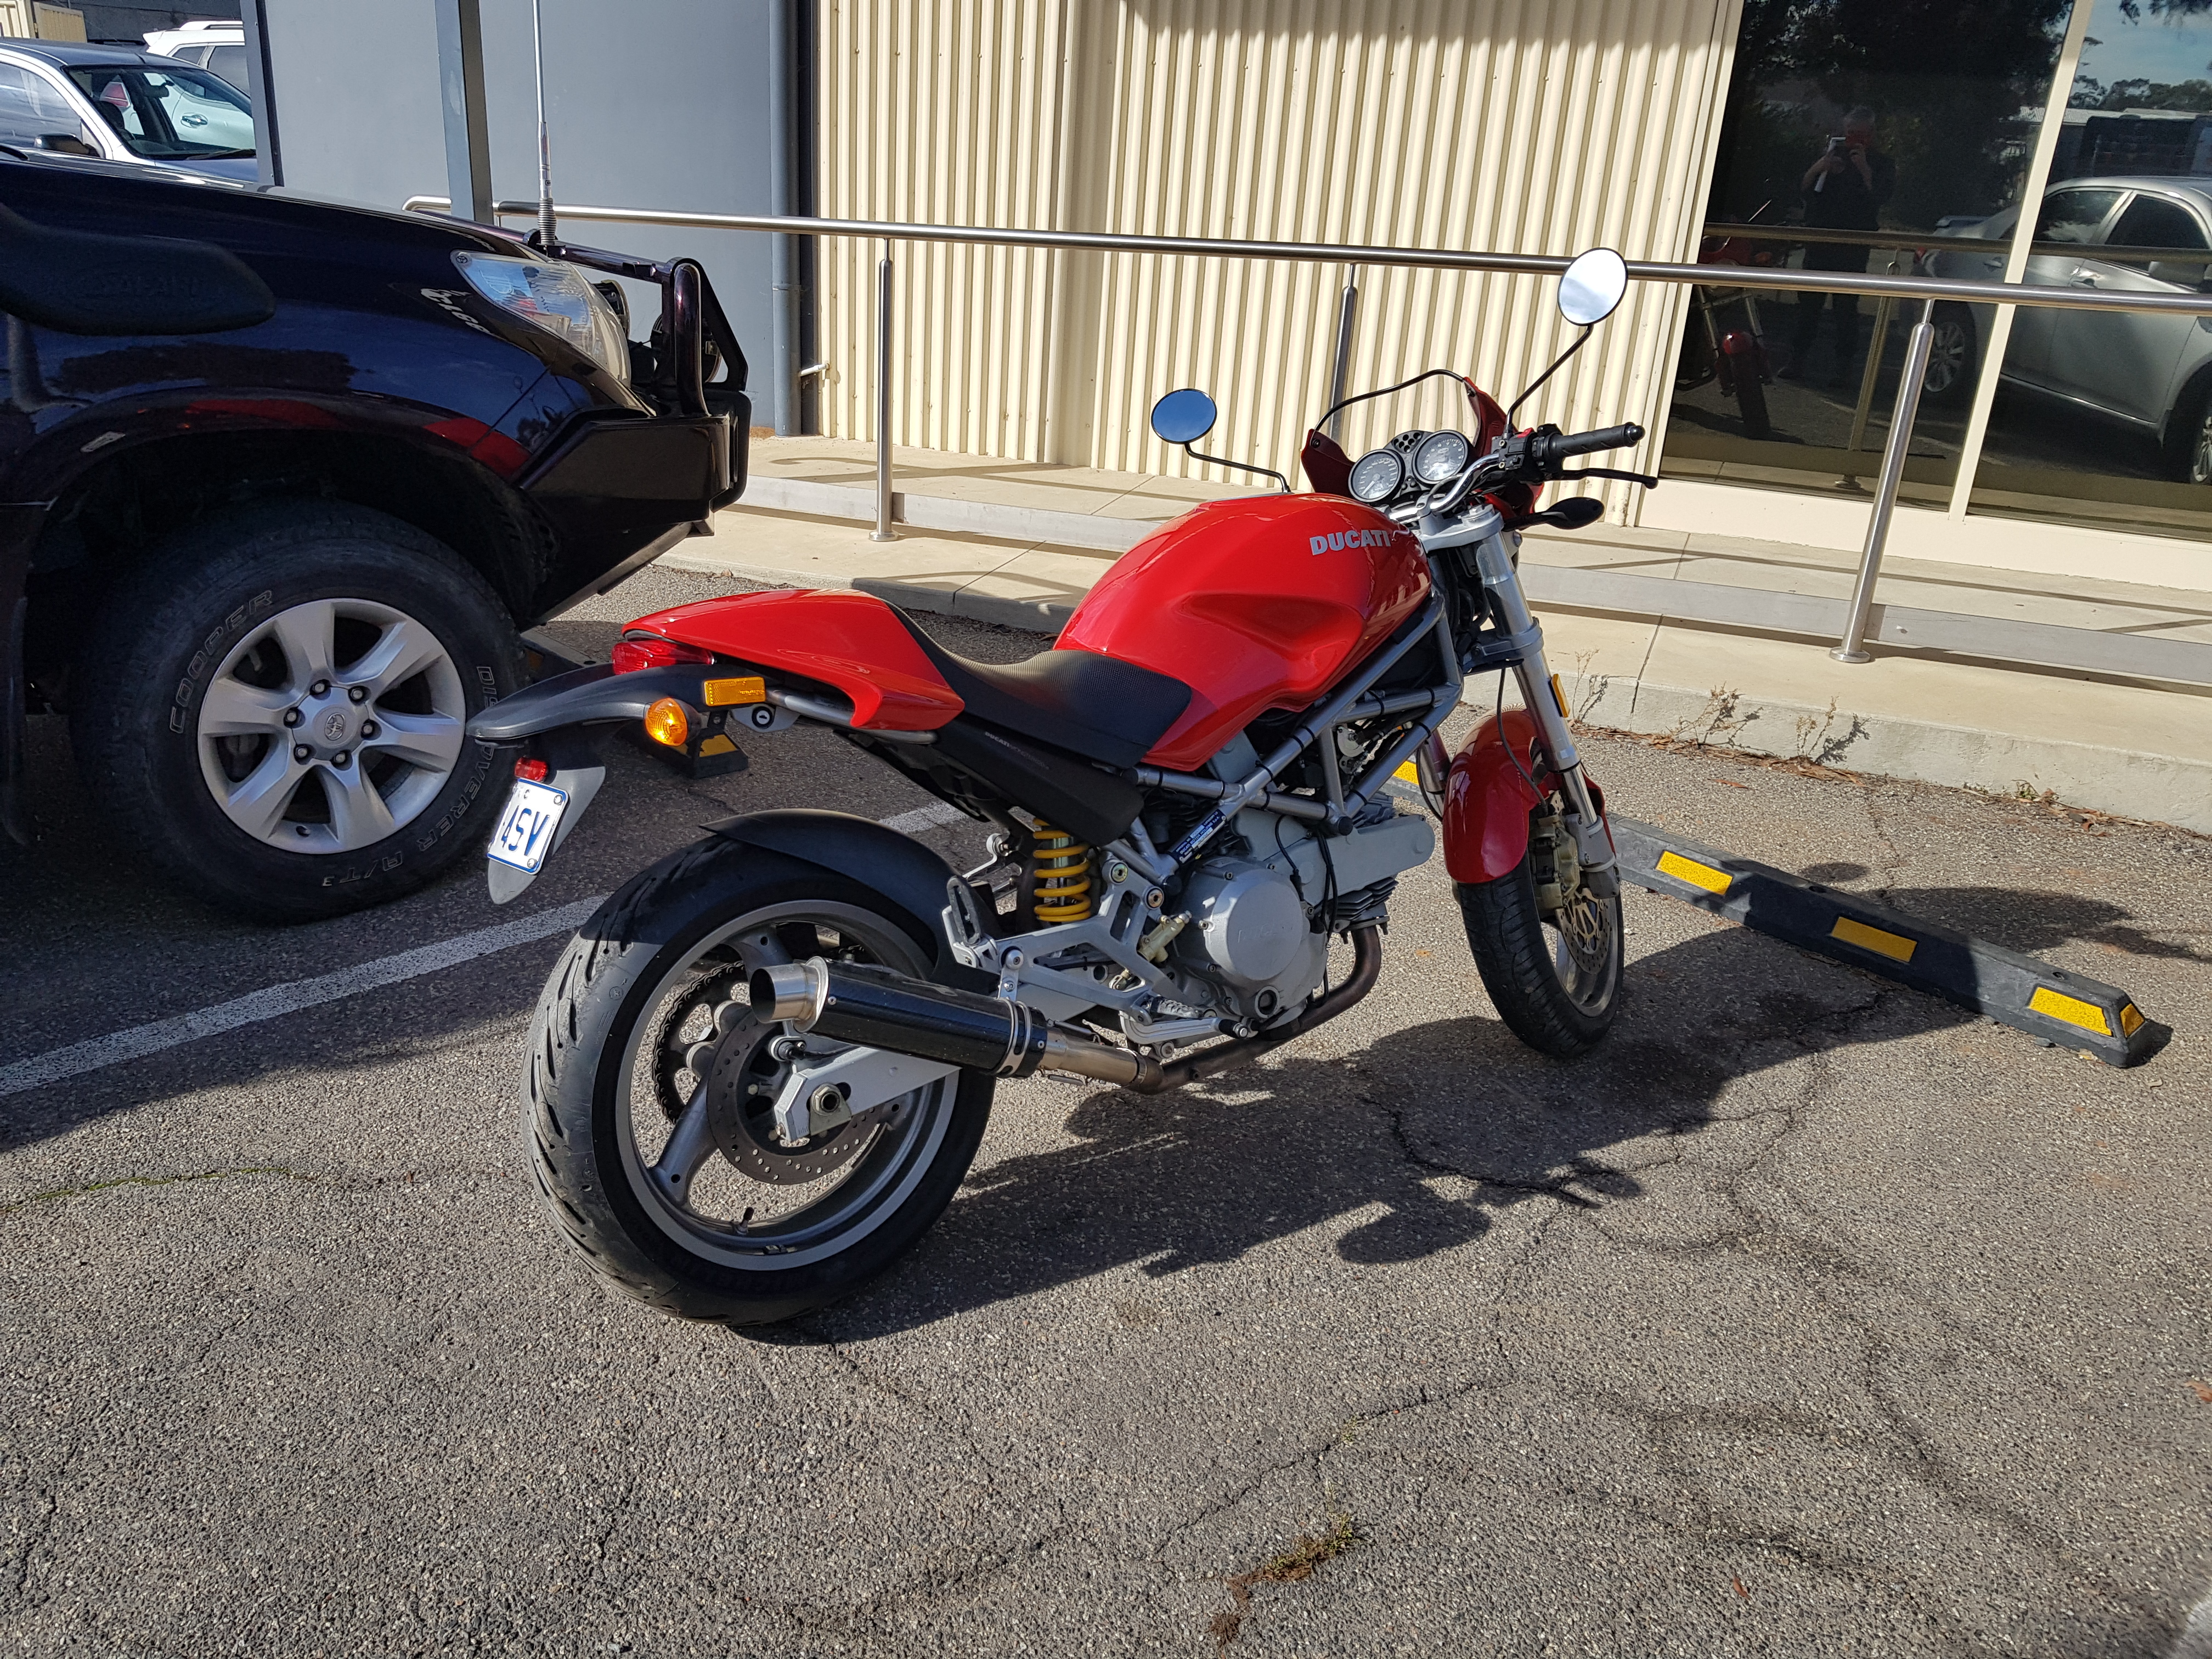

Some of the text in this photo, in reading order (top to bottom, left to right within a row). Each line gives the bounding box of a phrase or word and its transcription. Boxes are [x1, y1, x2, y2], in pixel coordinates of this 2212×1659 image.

[1309, 529, 1391, 556] DUCATI
[169, 589, 273, 734] COOPER
[416, 665, 499, 853] DISOVERER
[1180, 843, 1190, 854] DUCATI
